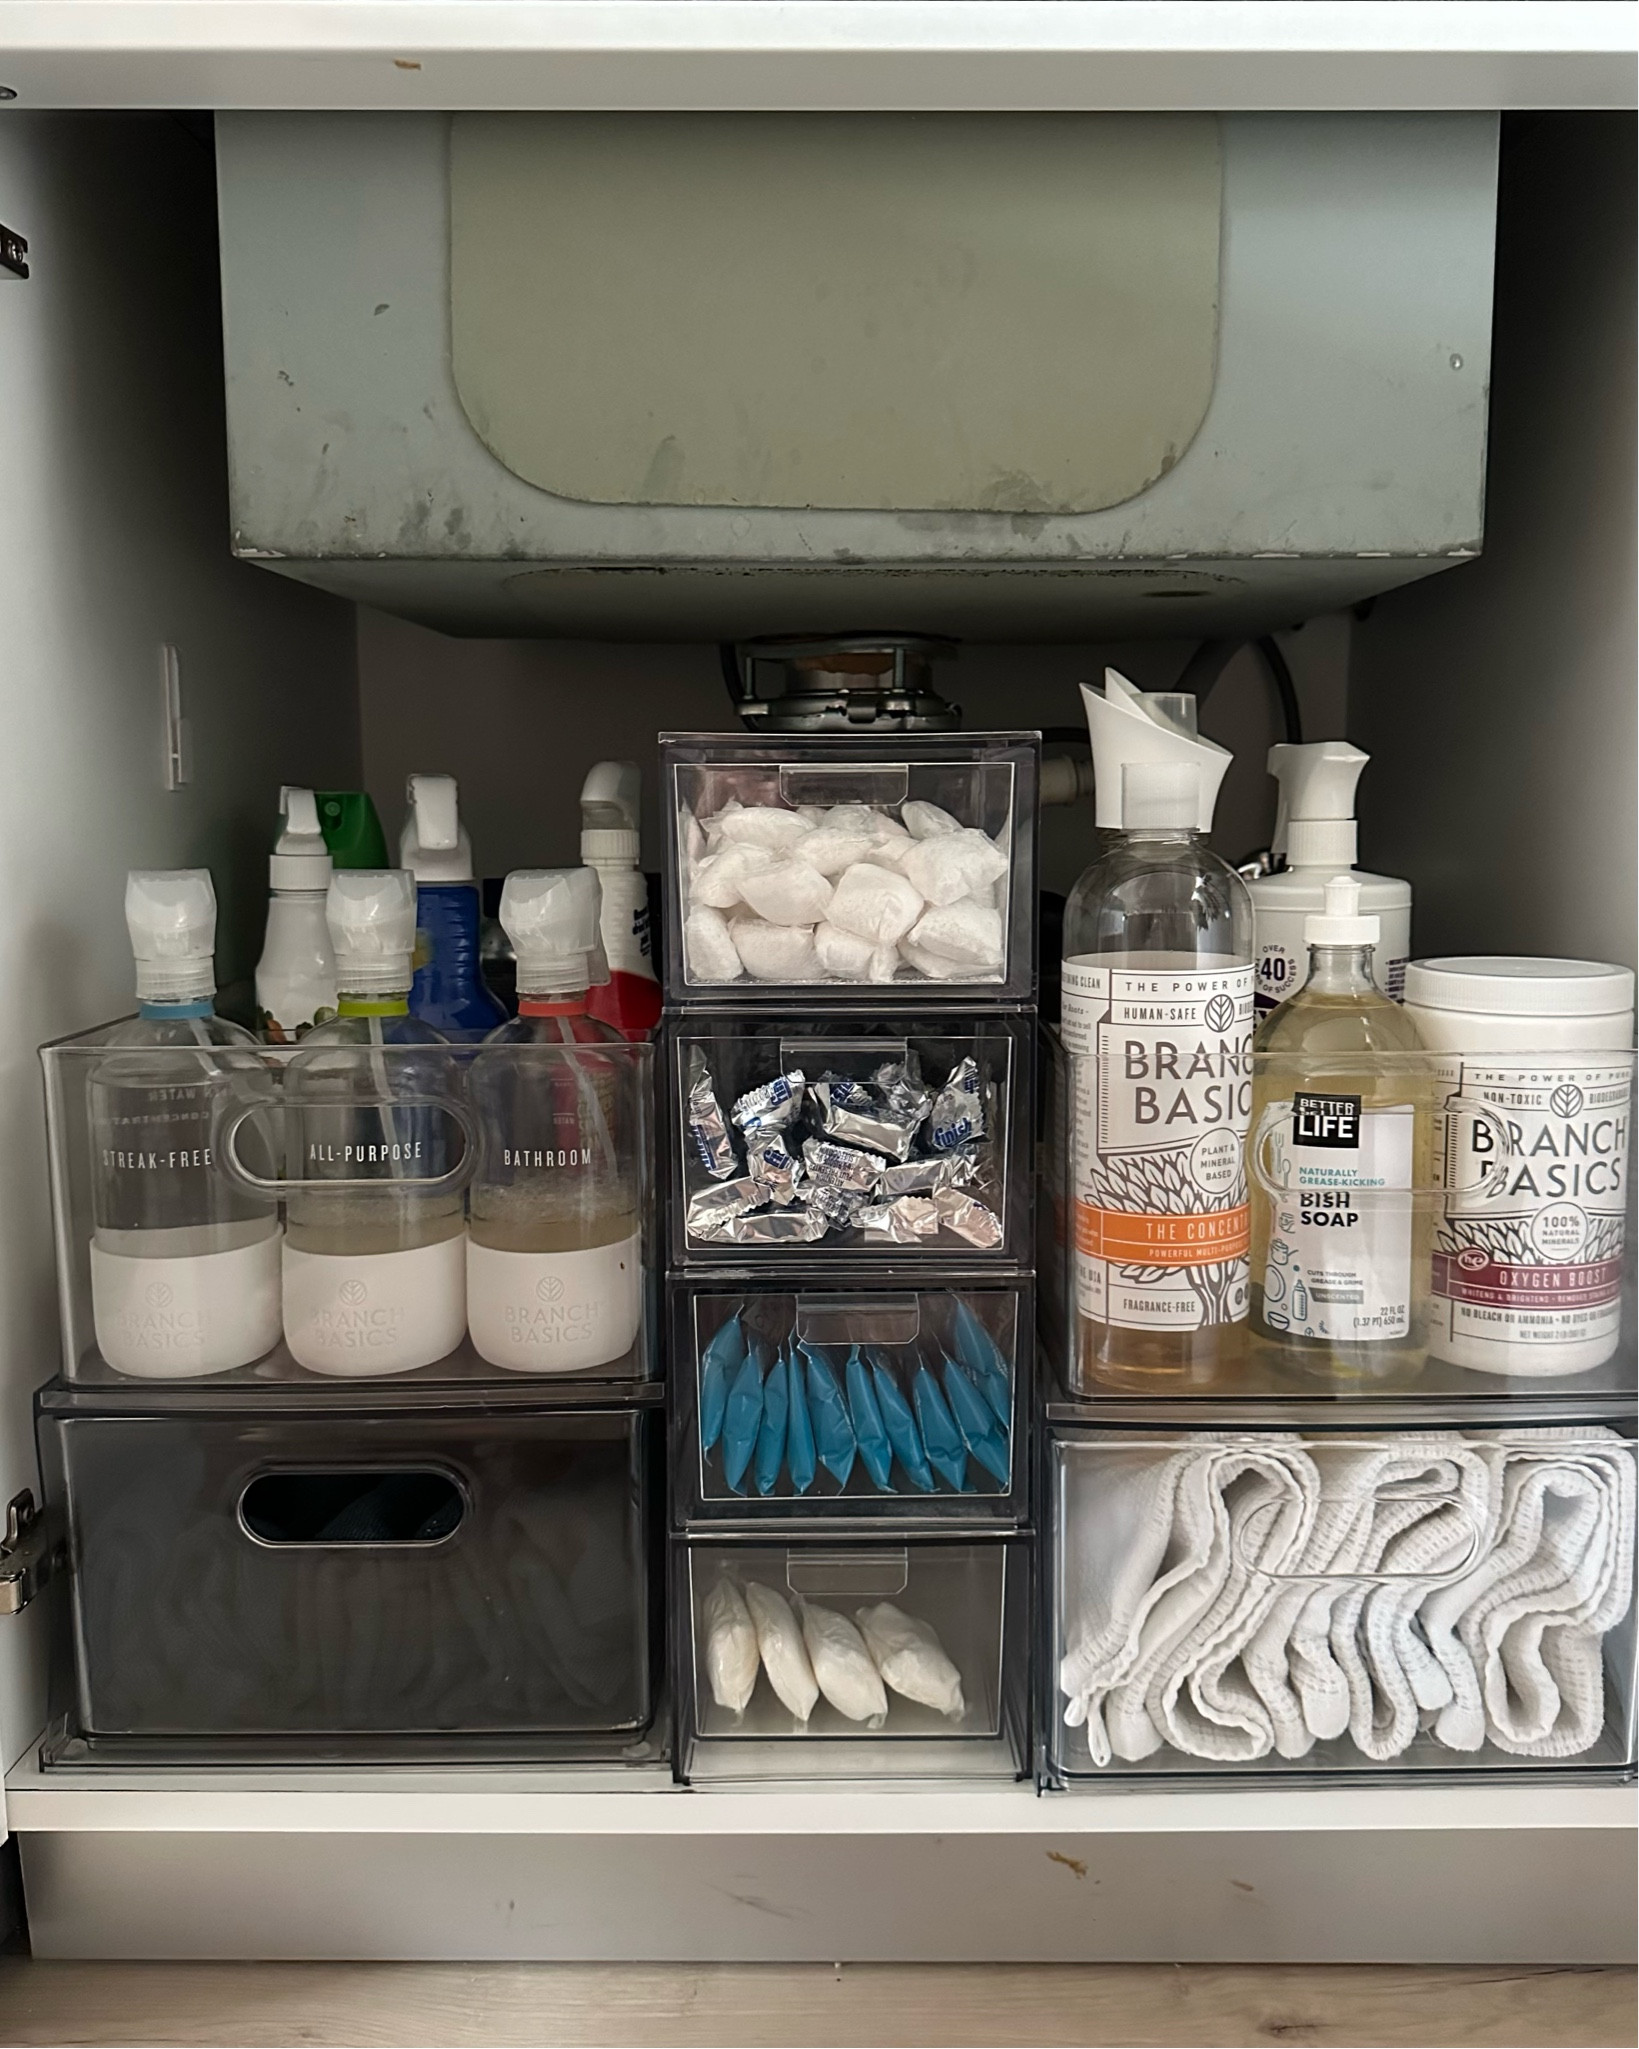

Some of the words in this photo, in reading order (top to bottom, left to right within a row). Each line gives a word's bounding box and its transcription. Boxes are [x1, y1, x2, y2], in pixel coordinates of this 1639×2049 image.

[1262, 944, 1286, 954] OVER
[1260, 957, 1286, 981] 40
[1274, 958, 1297, 993] SUCCESS
[1125, 982, 1159, 992] THE
[1173, 980, 1229, 992] POWER
[1237, 977, 1248, 988] OF
[1124, 1007, 1196, 1020] HUMAN-SAFE
[1475, 1073, 1505, 1081] THE
[1519, 1074, 1575, 1082] POWER
[1586, 1073, 1601, 1081] OF
[1483, 1091, 1542, 1106] NON-TOXIC
[1300, 1098, 1355, 1115] BETTER
[1299, 1115, 1354, 1138] LIFE
[1472, 1115, 1628, 1157] BRANCH
[310, 1141, 423, 1162] ALL-PURPOSE
[504, 1148, 592, 1167] BATHROOM
[1201, 1146, 1228, 1155] PLANT
[103, 1149, 212, 1168] STREAK-FREE
[1201, 1158, 1236, 1169] MINERAL
[1206, 1170, 1232, 1180] BASED
[1299, 1167, 1358, 1177] NATURALLY
[1300, 1177, 1385, 1186] GREASE-KICKING
[1301, 1211, 1359, 1227] SOAP
[1543, 1216, 1580, 1227] 100%
[1146, 1222, 1176, 1240] THE
[1542, 1237, 1580, 1245] MINERALS
[1149, 1248, 1192, 1258] POWERFUL
[1500, 1270, 1560, 1288] OXYGEN
[1569, 1267, 1607, 1286] BOOST
[1461, 1287, 1495, 1299] WHITENS
[1123, 1299, 1196, 1313] FRAGRANCE-FREE
[1380, 1306, 1389, 1315] 22
[505, 1304, 599, 1326] BRANCH
[1461, 1307, 1471, 1316] NO
[1473, 1308, 1501, 1321] BLEACH
[510, 1325, 593, 1344] BASICS
